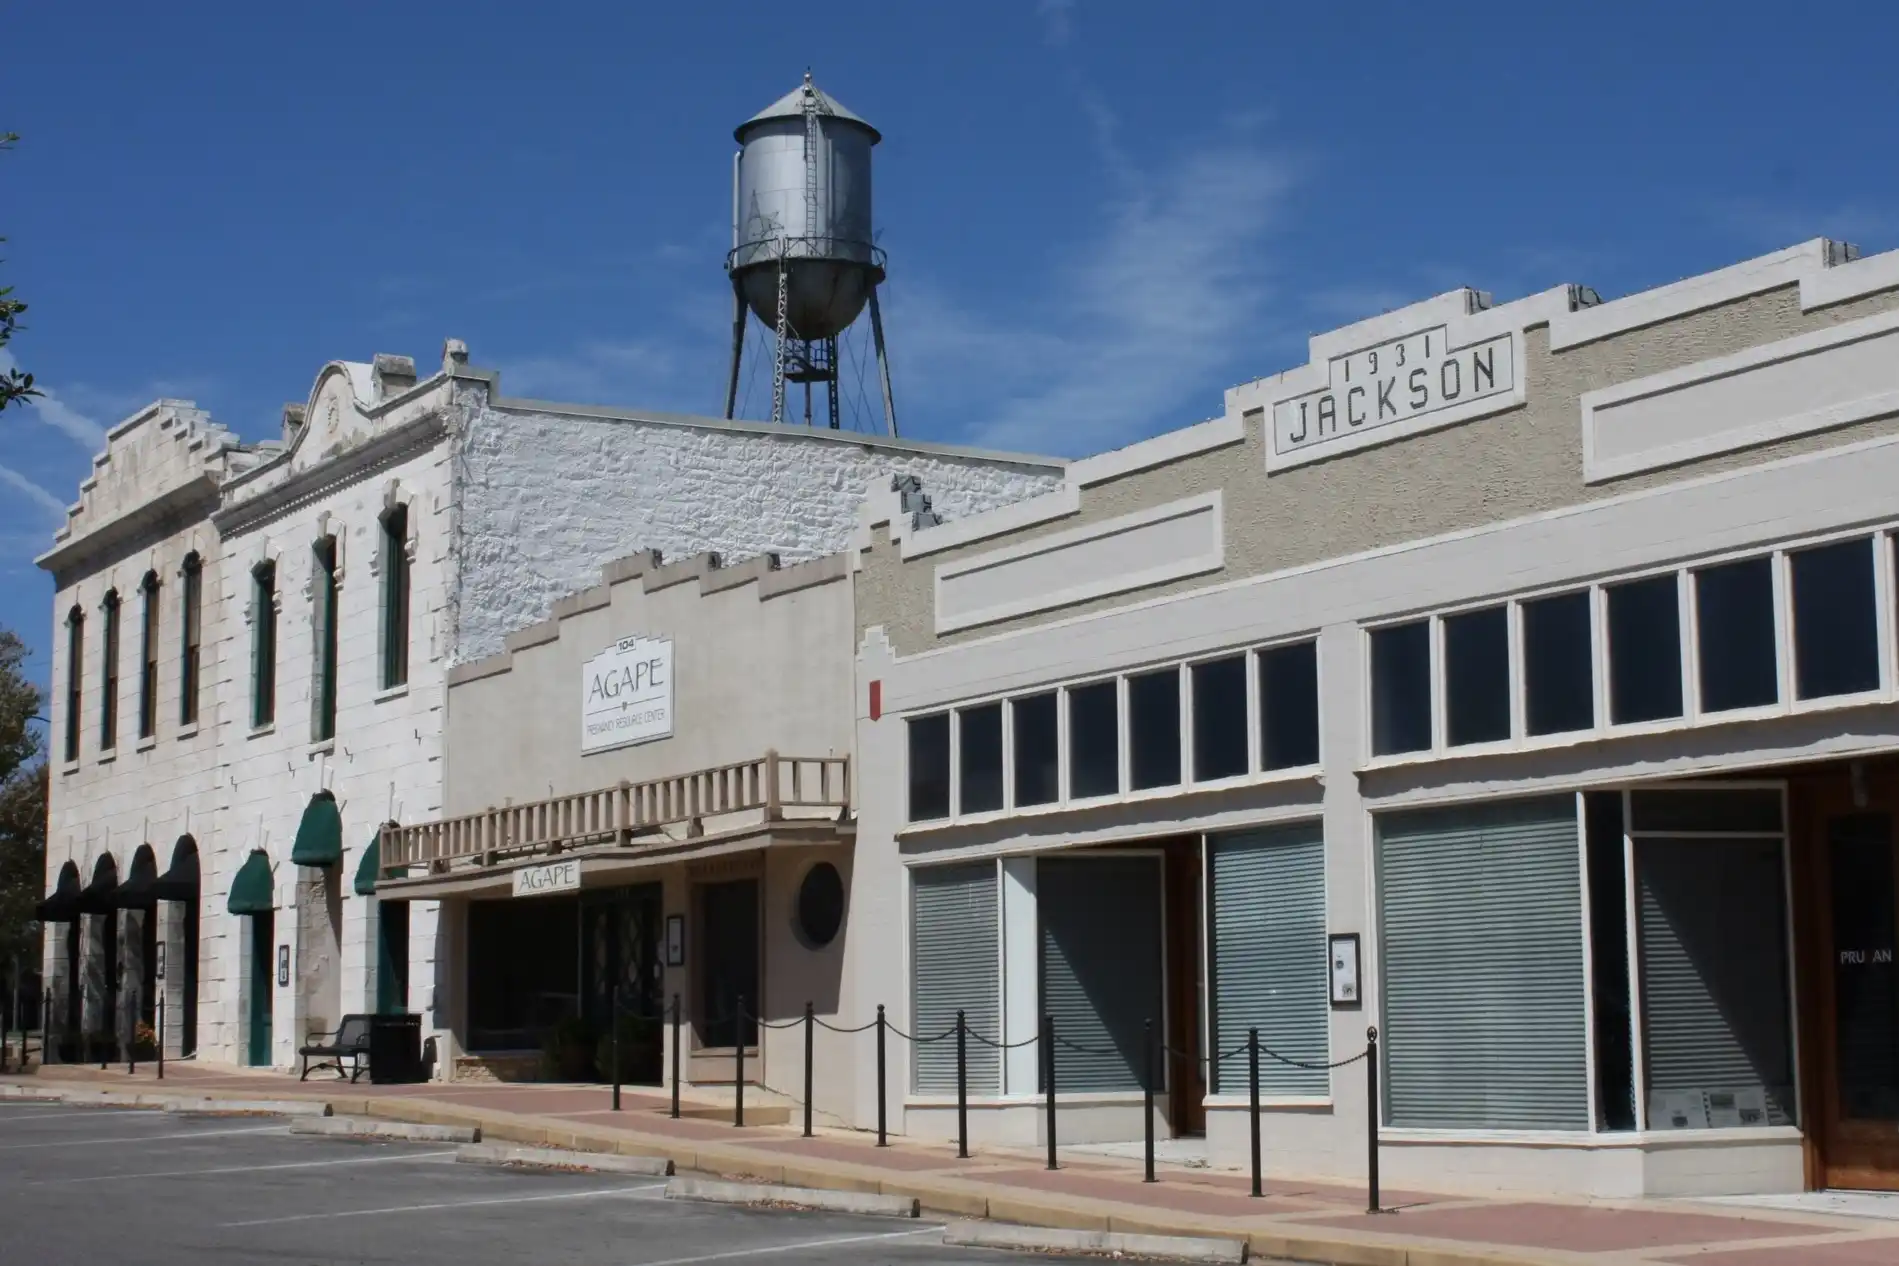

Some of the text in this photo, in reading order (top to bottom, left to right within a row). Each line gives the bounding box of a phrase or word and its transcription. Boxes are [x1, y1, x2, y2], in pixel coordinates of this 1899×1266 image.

[1344, 335, 1431, 382] 1931
[1290, 347, 1495, 443] JACKSON
[618, 639, 635, 652] 104
[588, 657, 664, 704] AGAPE
[644, 708, 666, 724] CENTER
[518, 864, 576, 892] AGAPE
